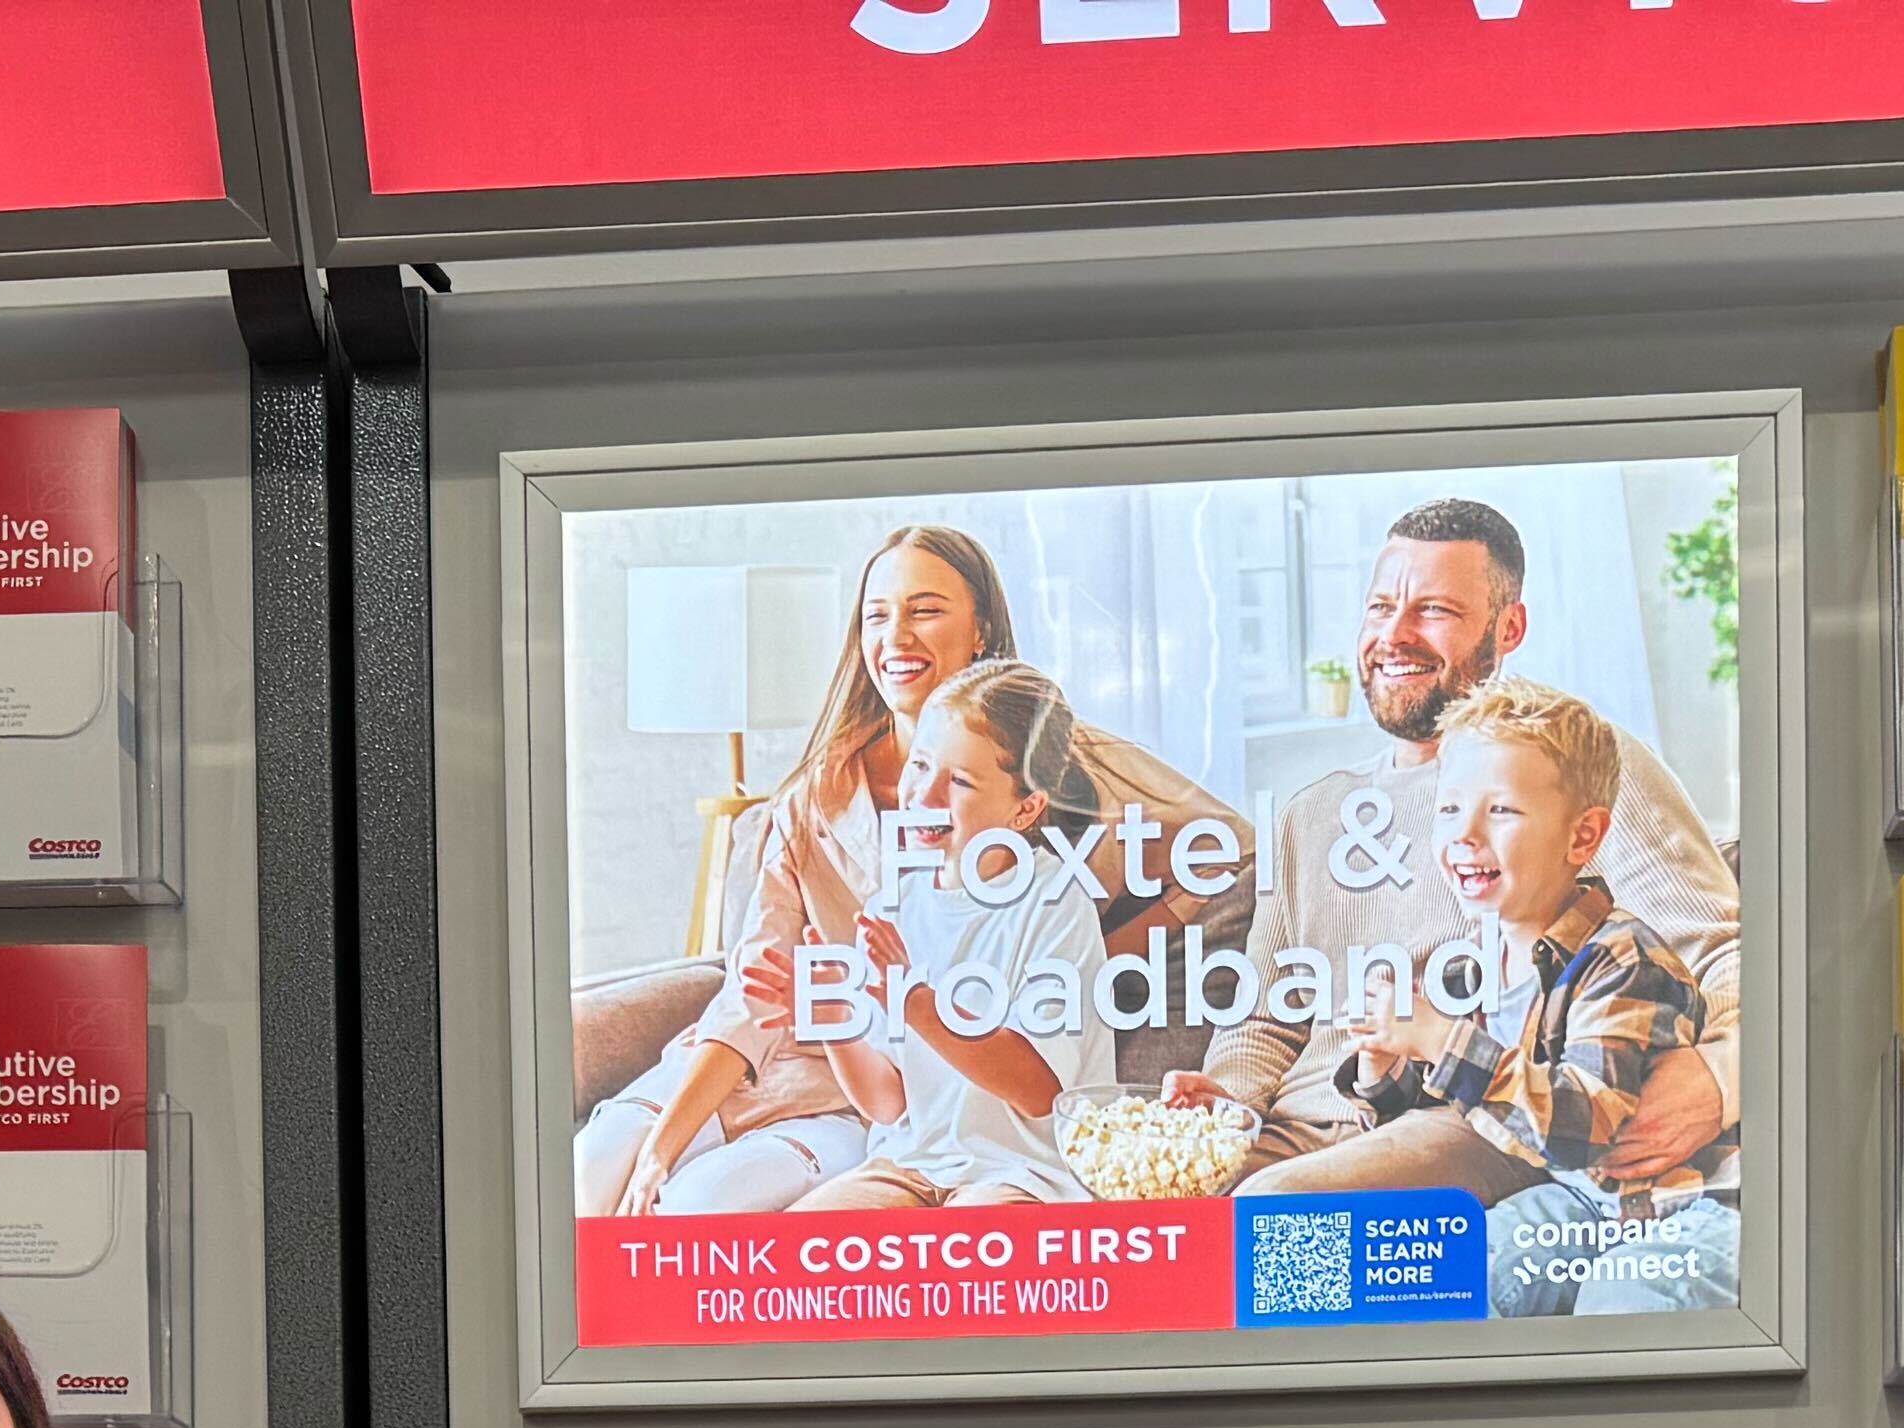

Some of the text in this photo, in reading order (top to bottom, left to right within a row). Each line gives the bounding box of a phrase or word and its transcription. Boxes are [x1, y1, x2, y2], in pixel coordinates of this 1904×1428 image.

[880, 787, 1414, 908] Foxtel &
[794, 914, 1501, 1042] Broadband
[1365, 1216, 1468, 1239] SCAN TO
[1514, 1217, 1681, 1251] compare
[622, 1225, 1186, 1277] THINK COSTCO FIRST
[1366, 1242, 1443, 1260] LEARN
[1546, 1249, 1700, 1284] connect
[1366, 1266, 1432, 1285] MORE
[696, 1276, 1108, 1322] FOR CONNECTING TO THE WORLD
